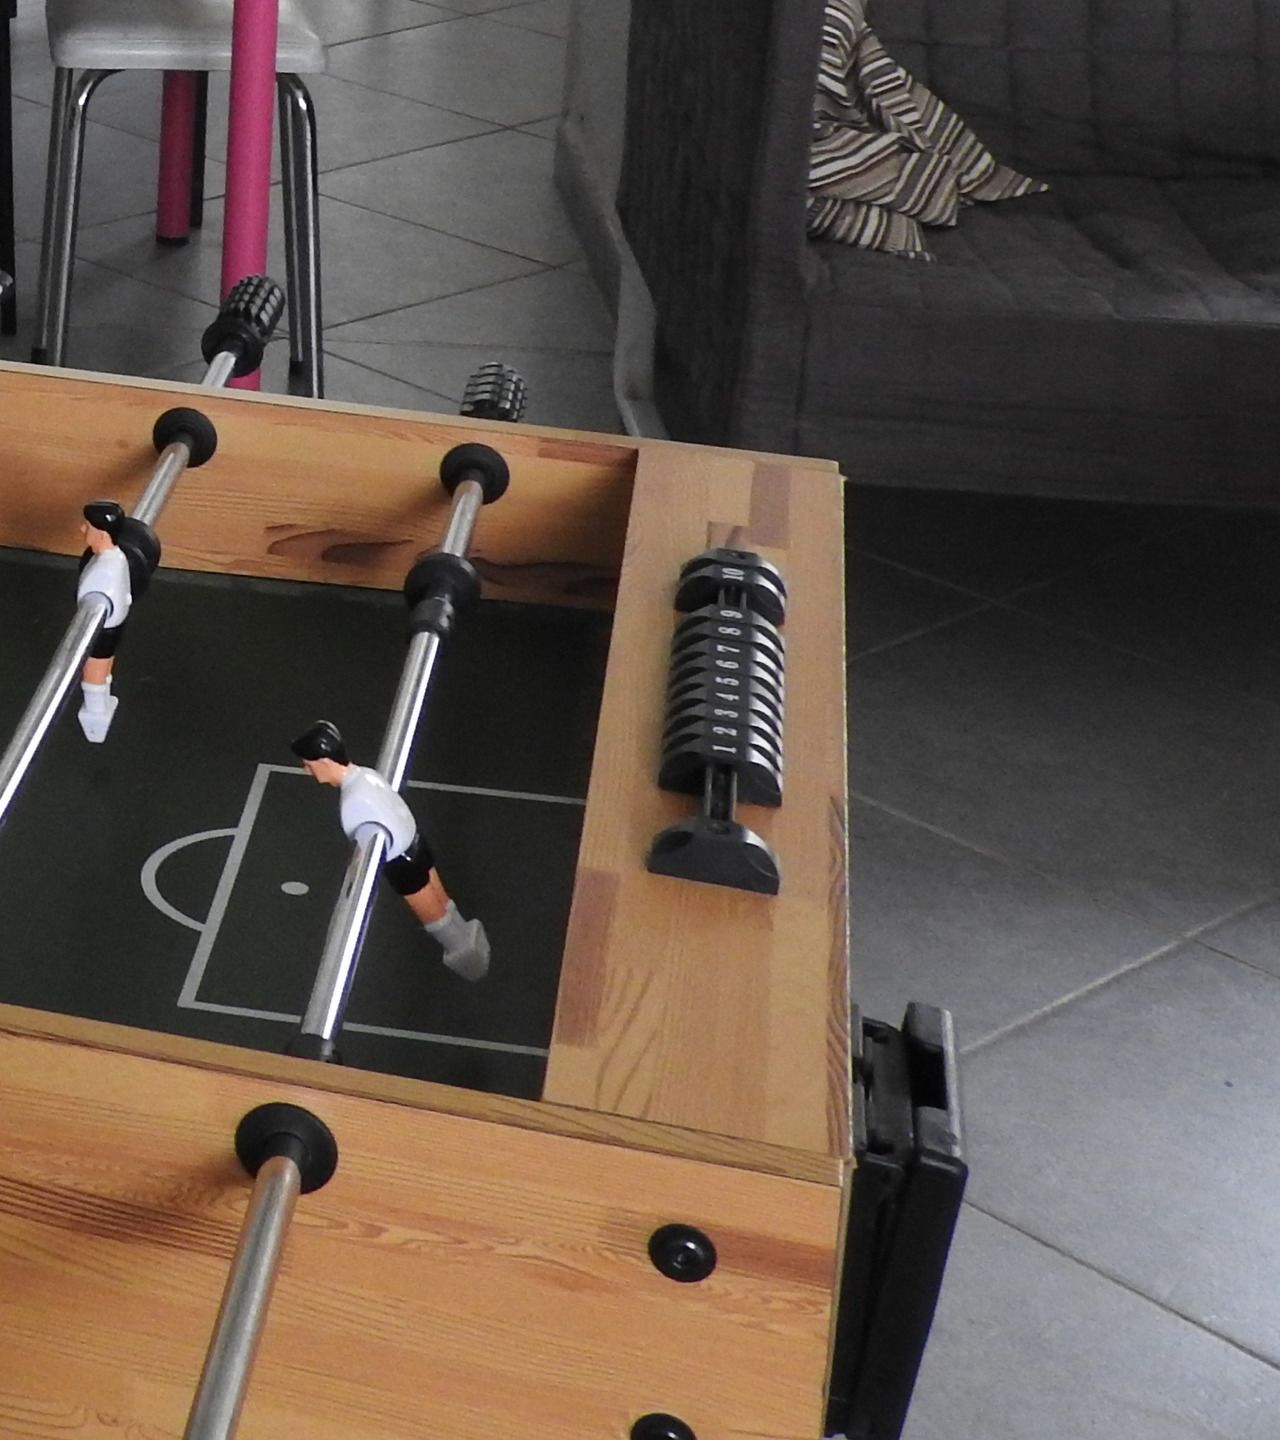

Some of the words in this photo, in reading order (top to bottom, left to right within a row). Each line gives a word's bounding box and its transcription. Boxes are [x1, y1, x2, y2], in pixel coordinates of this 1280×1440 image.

[721, 567, 744, 581] 10
[720, 609, 743, 619] 9
[717, 626, 741, 636] 8
[716, 644, 740, 653] 7
[715, 659, 739, 669] 6
[715, 677, 739, 686] 5
[715, 692, 739, 701] 4
[714, 708, 738, 718] 3
[712, 726, 737, 736] 2
[712, 745, 737, 754] 1
